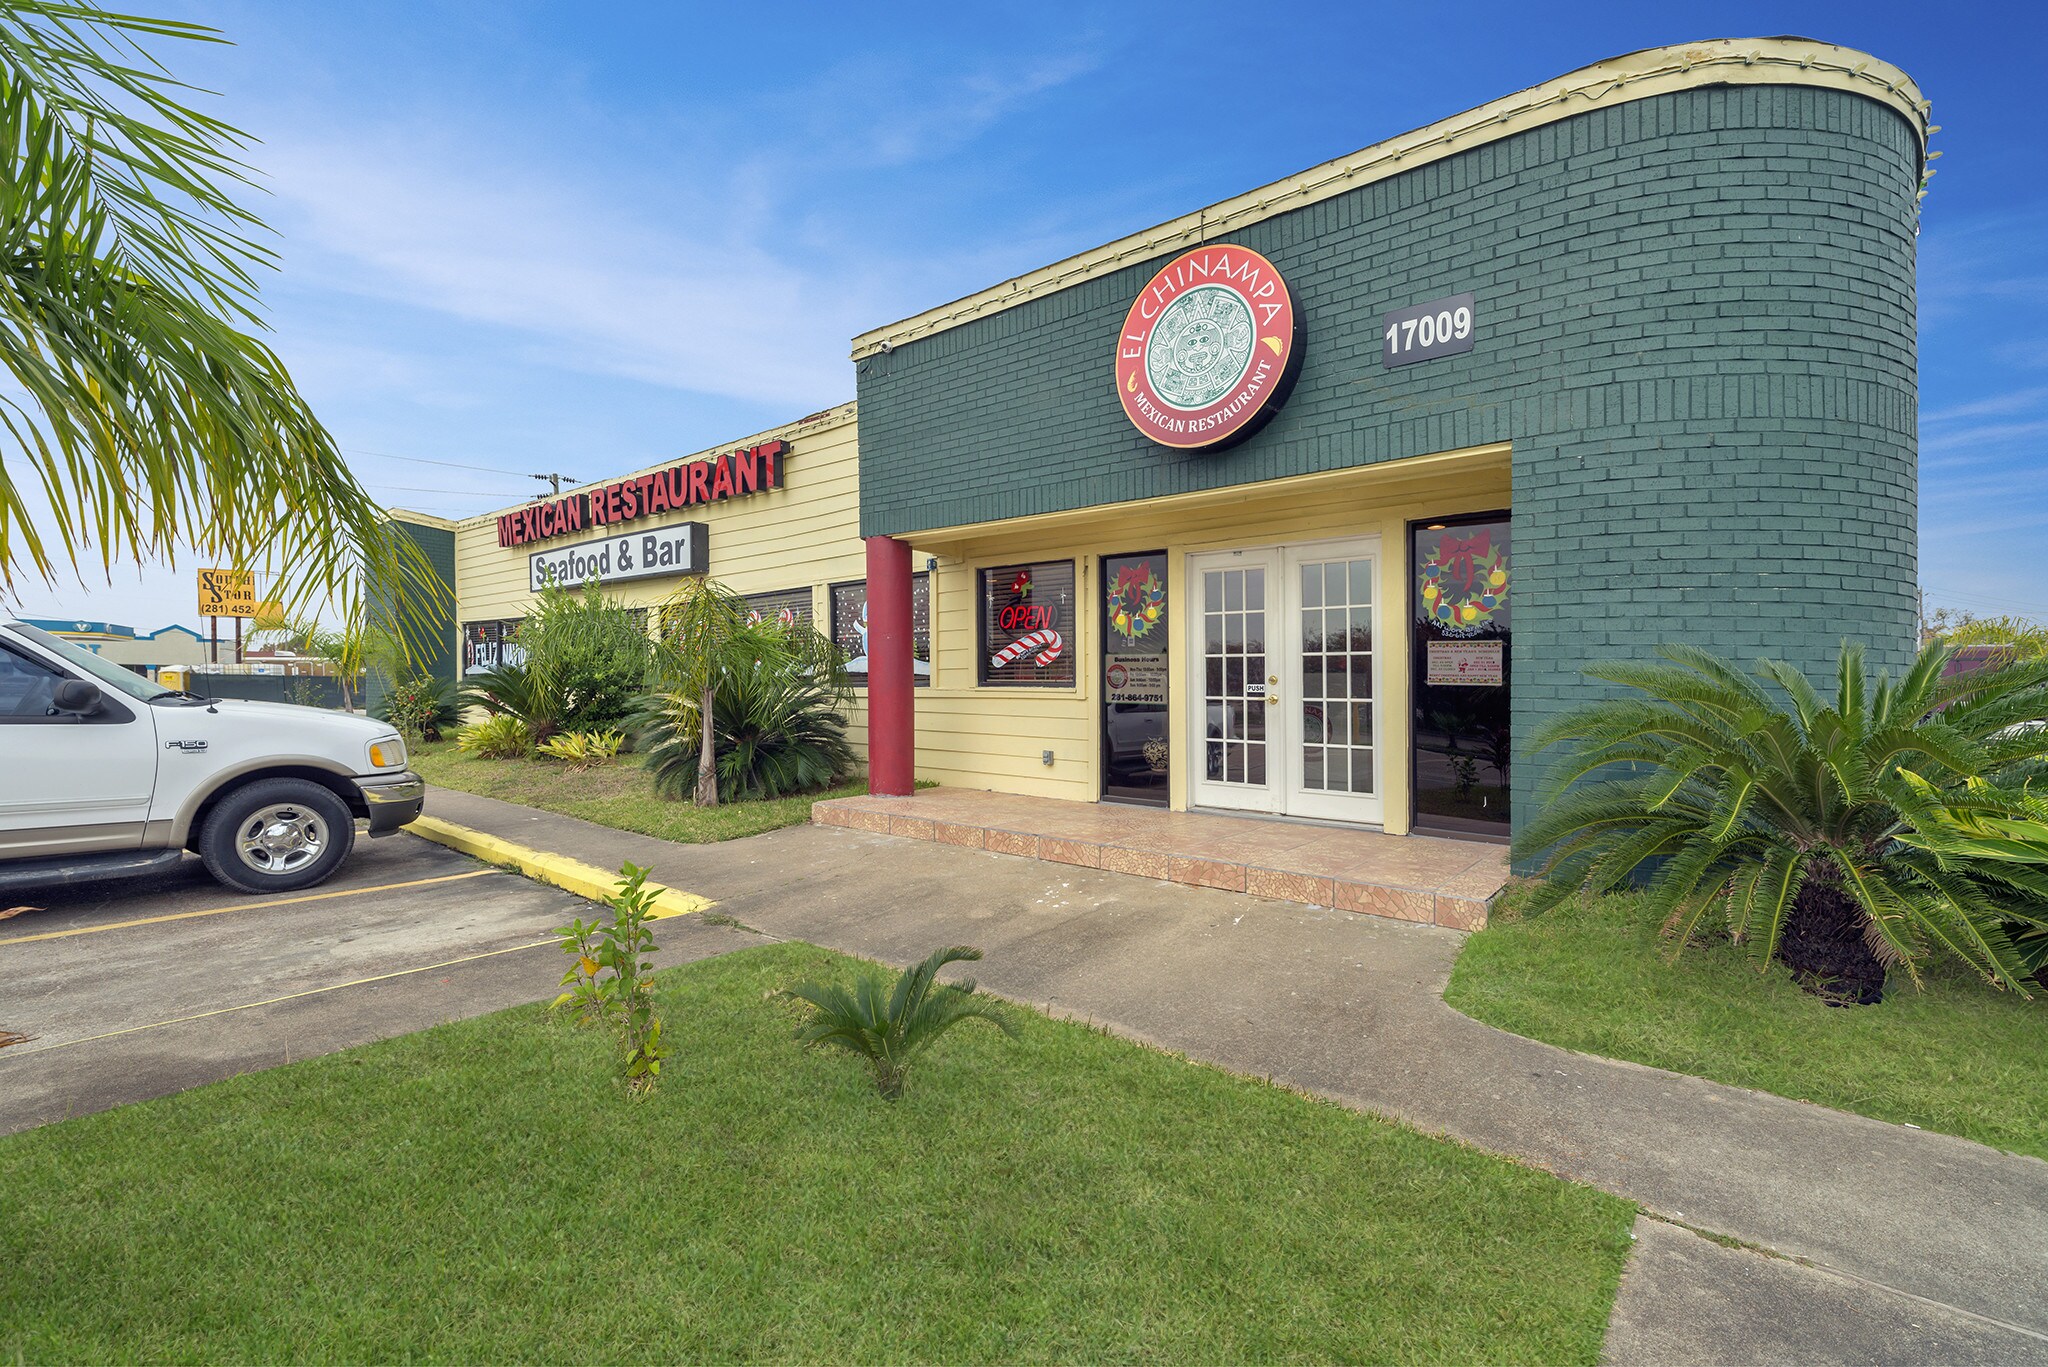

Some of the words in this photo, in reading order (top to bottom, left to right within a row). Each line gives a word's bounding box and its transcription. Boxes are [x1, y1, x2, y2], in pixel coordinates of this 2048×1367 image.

[1122, 330, 1147, 359] EL
[1141, 253, 1284, 327] CHINAMPA
[1385, 305, 1471, 355] 17009
[1134, 391, 1185, 433] MEXICAN
[1187, 359, 1272, 434] RESTAURANT
[497, 493, 582, 548] MEXICAN
[591, 440, 784, 526] RESTAURANT
[535, 543, 611, 586] Seafood
[617, 539, 634, 572] &
[642, 535, 686, 569] Bar
[201, 604, 229, 615] (281)
[1000, 605, 1053, 630] OPEN
[475, 642, 498, 667] FELIZ
